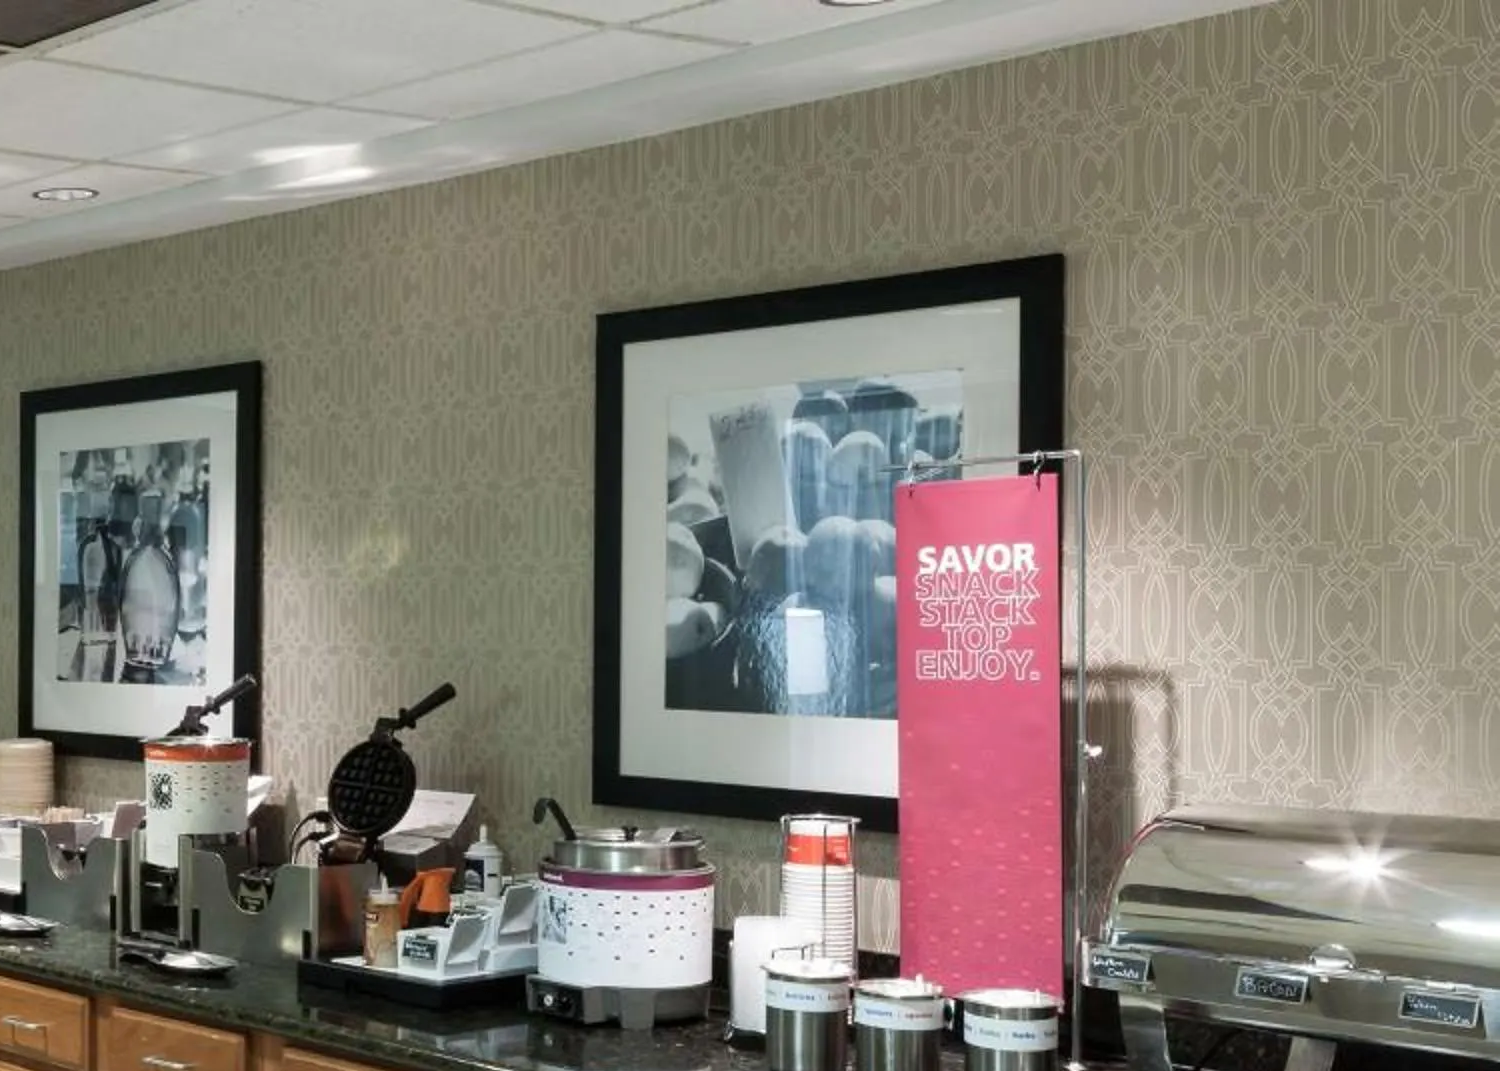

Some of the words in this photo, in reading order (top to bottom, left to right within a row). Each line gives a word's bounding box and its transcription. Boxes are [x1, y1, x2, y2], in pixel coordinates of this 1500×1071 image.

[917, 543, 1035, 574] SAVOR
[915, 567, 1041, 600] SNACK
[919, 596, 1037, 627] STACK
[941, 623, 1012, 652] TOP
[915, 650, 1041, 681] ENJOY.
